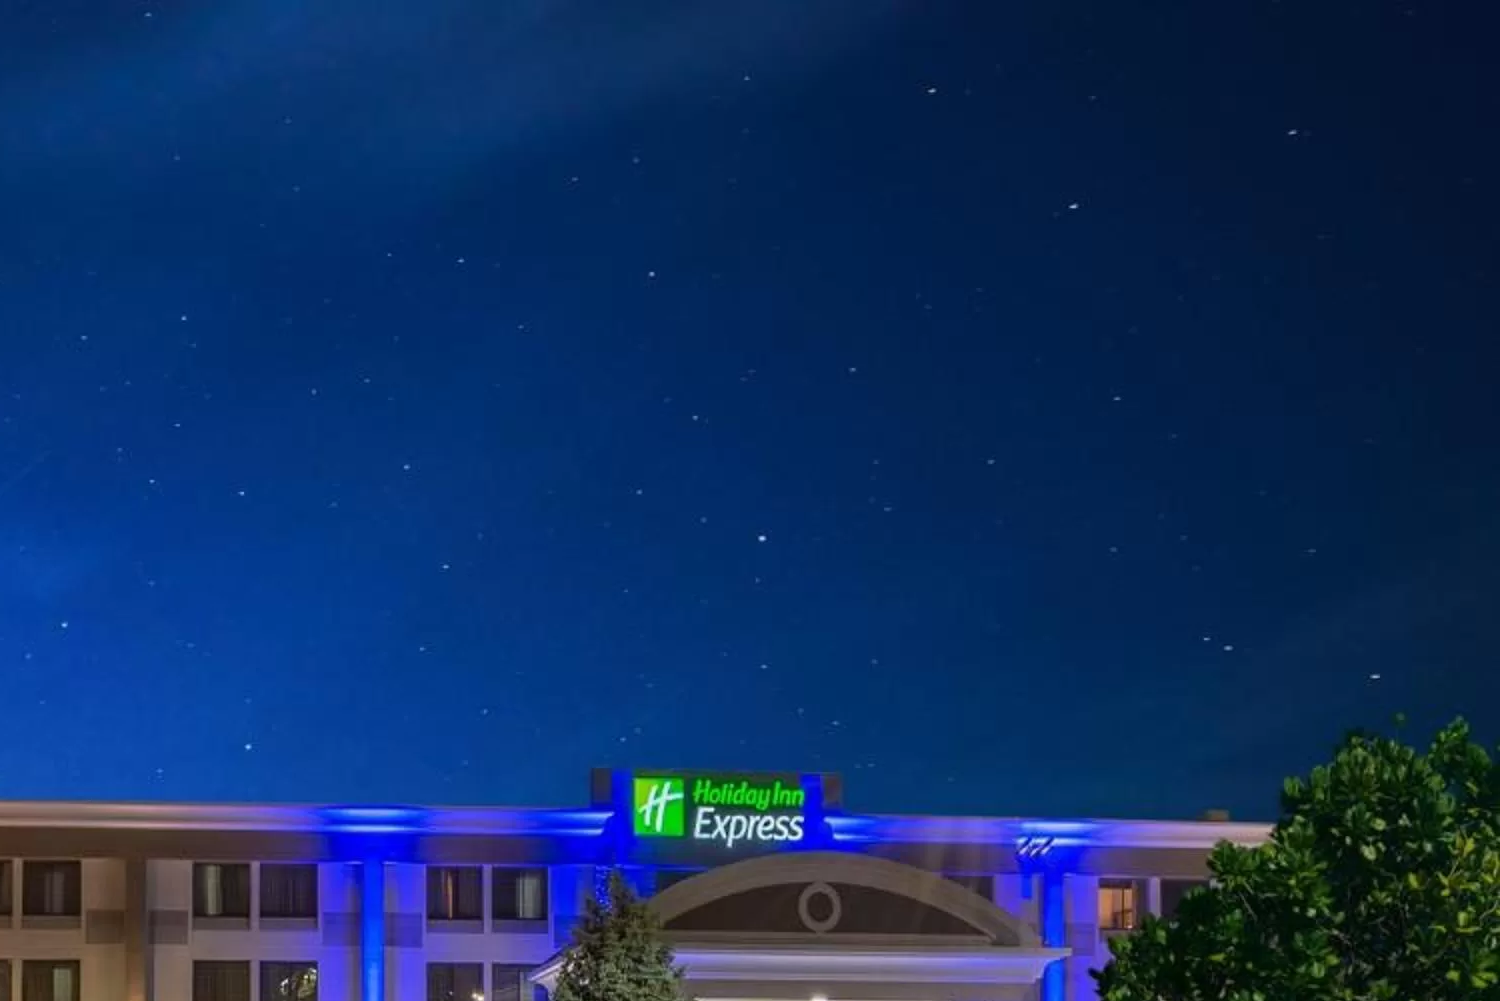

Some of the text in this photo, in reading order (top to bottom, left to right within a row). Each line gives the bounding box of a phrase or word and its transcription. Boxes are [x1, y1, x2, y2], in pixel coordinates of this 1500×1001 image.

[693, 779, 805, 811] Holiday Inn
[694, 806, 805, 848] Express
